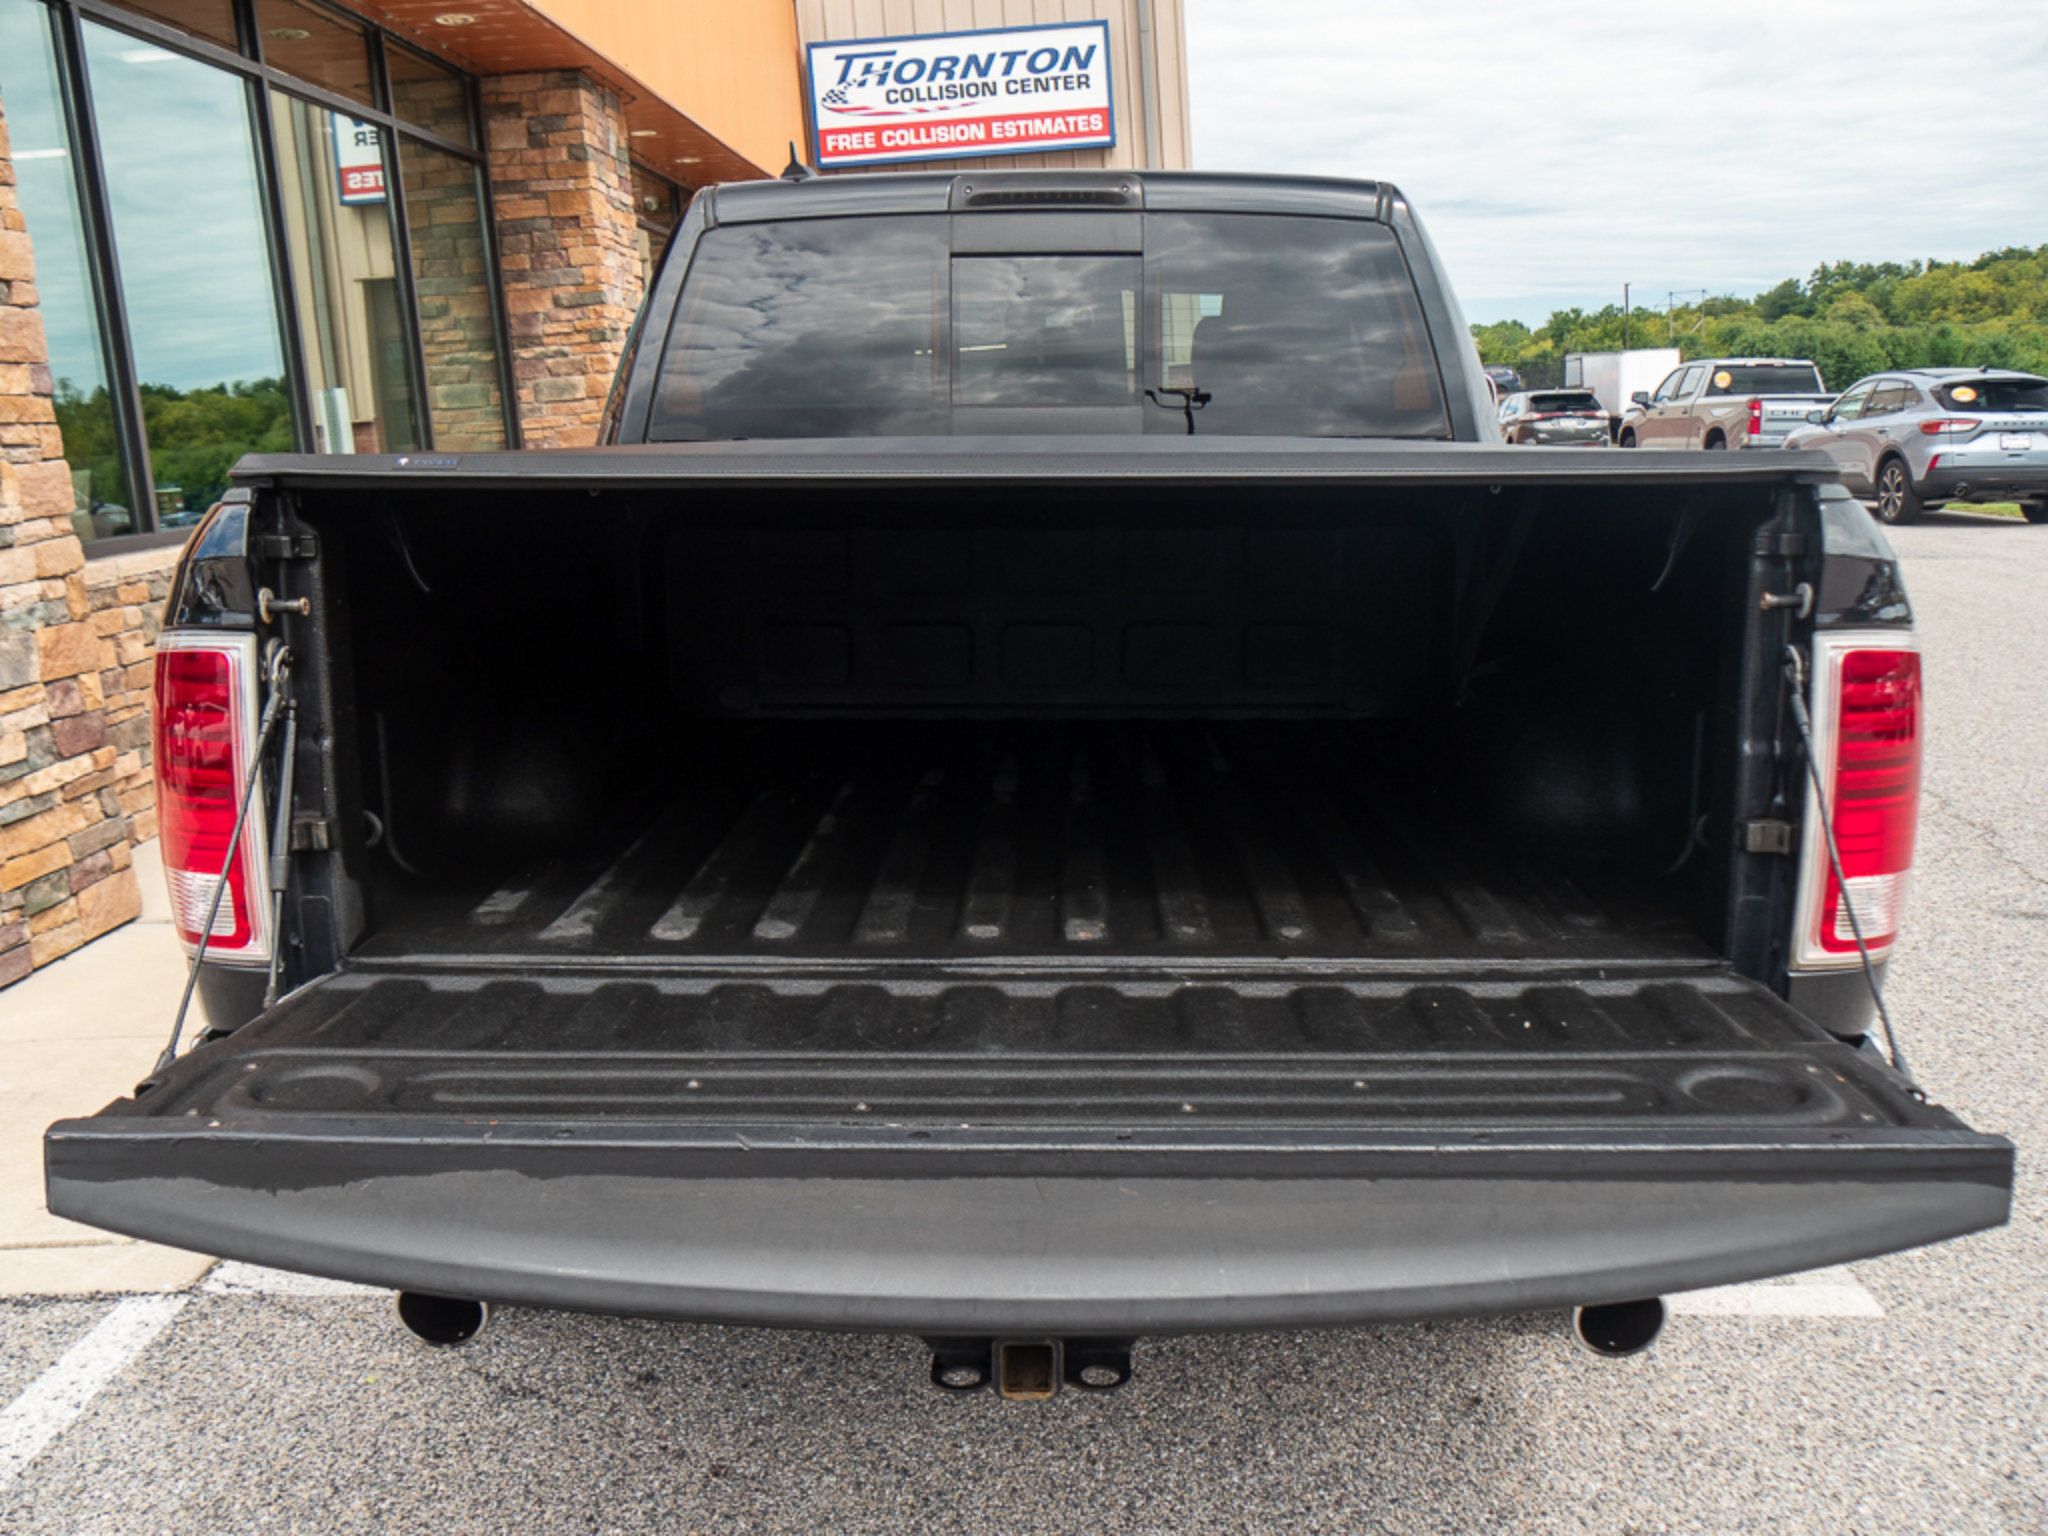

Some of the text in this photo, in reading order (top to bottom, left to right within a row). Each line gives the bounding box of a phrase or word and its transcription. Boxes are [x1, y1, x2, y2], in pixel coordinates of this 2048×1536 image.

[833, 44, 1097, 88] THORNTON
[885, 74, 1091, 105] COLLISION CENTER
[826, 114, 1103, 152] FREE COLLISION ESTIMATES
